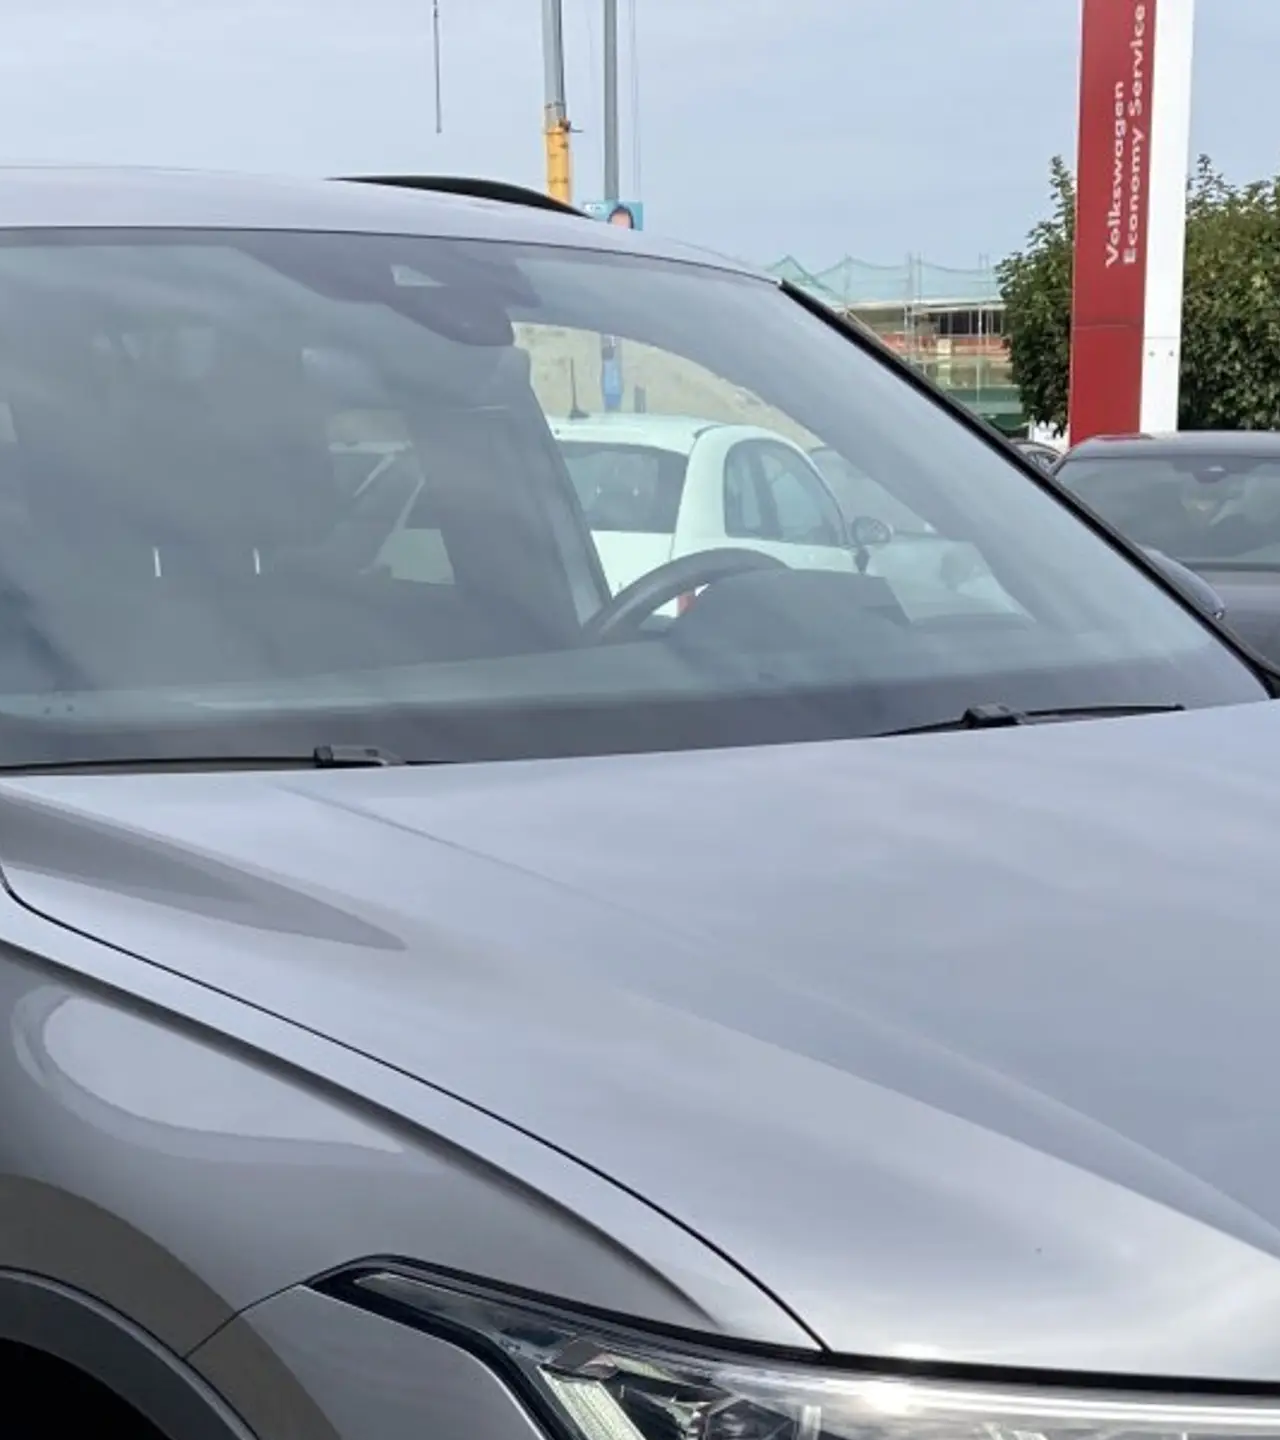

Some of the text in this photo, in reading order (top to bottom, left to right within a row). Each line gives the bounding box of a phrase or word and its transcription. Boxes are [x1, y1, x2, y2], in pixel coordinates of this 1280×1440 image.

[1105, 81, 1126, 268] Volkswagen
[1123, 4, 1146, 264] Economy Service
